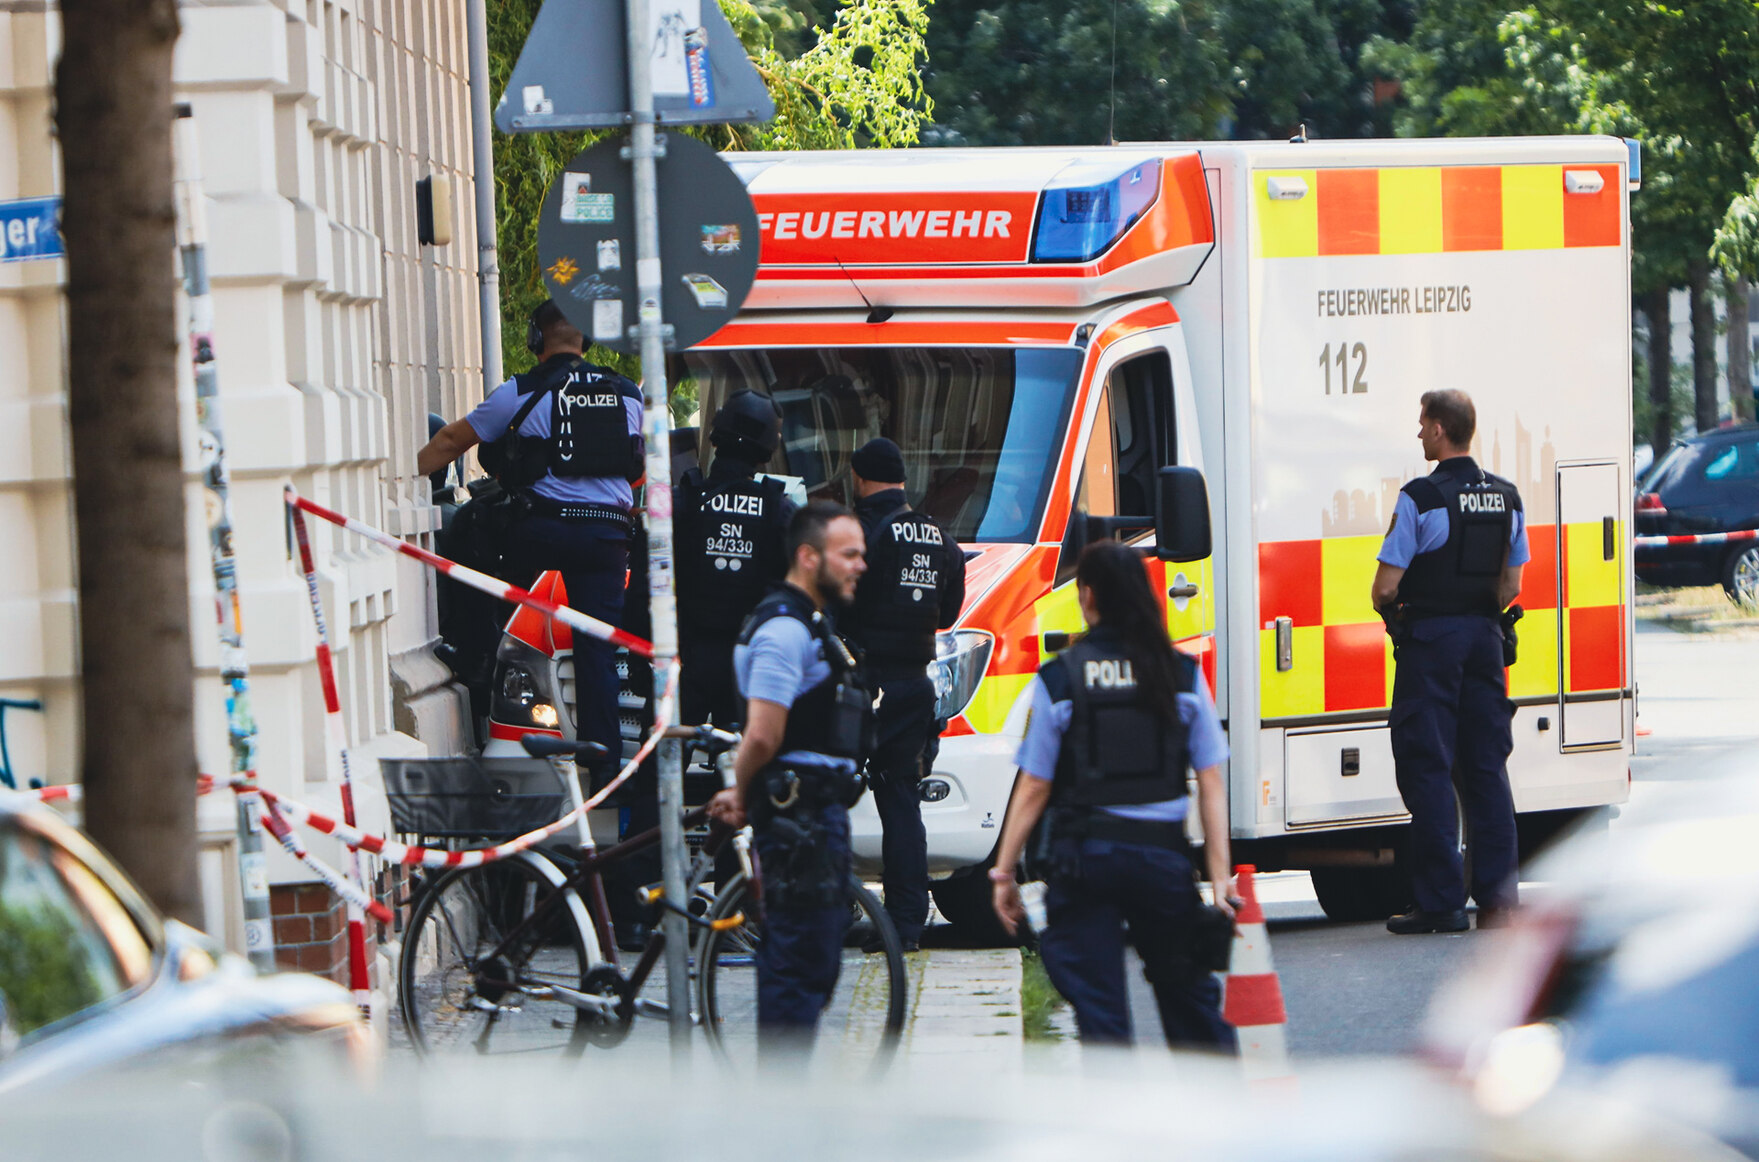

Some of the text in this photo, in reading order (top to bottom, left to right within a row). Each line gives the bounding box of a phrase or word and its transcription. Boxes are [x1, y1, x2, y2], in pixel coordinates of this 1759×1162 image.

[1317, 285, 1472, 317] FEUERWEHR LEIPZIG
[1319, 341, 1369, 395] 112
[567, 394, 618, 407] POLIZEI
[1459, 493, 1506, 513] POLIZEI
[720, 523, 743, 538] SN
[891, 522, 943, 546] POLIZEI
[706, 536, 753, 554] 94/330
[912, 553, 930, 569] SN
